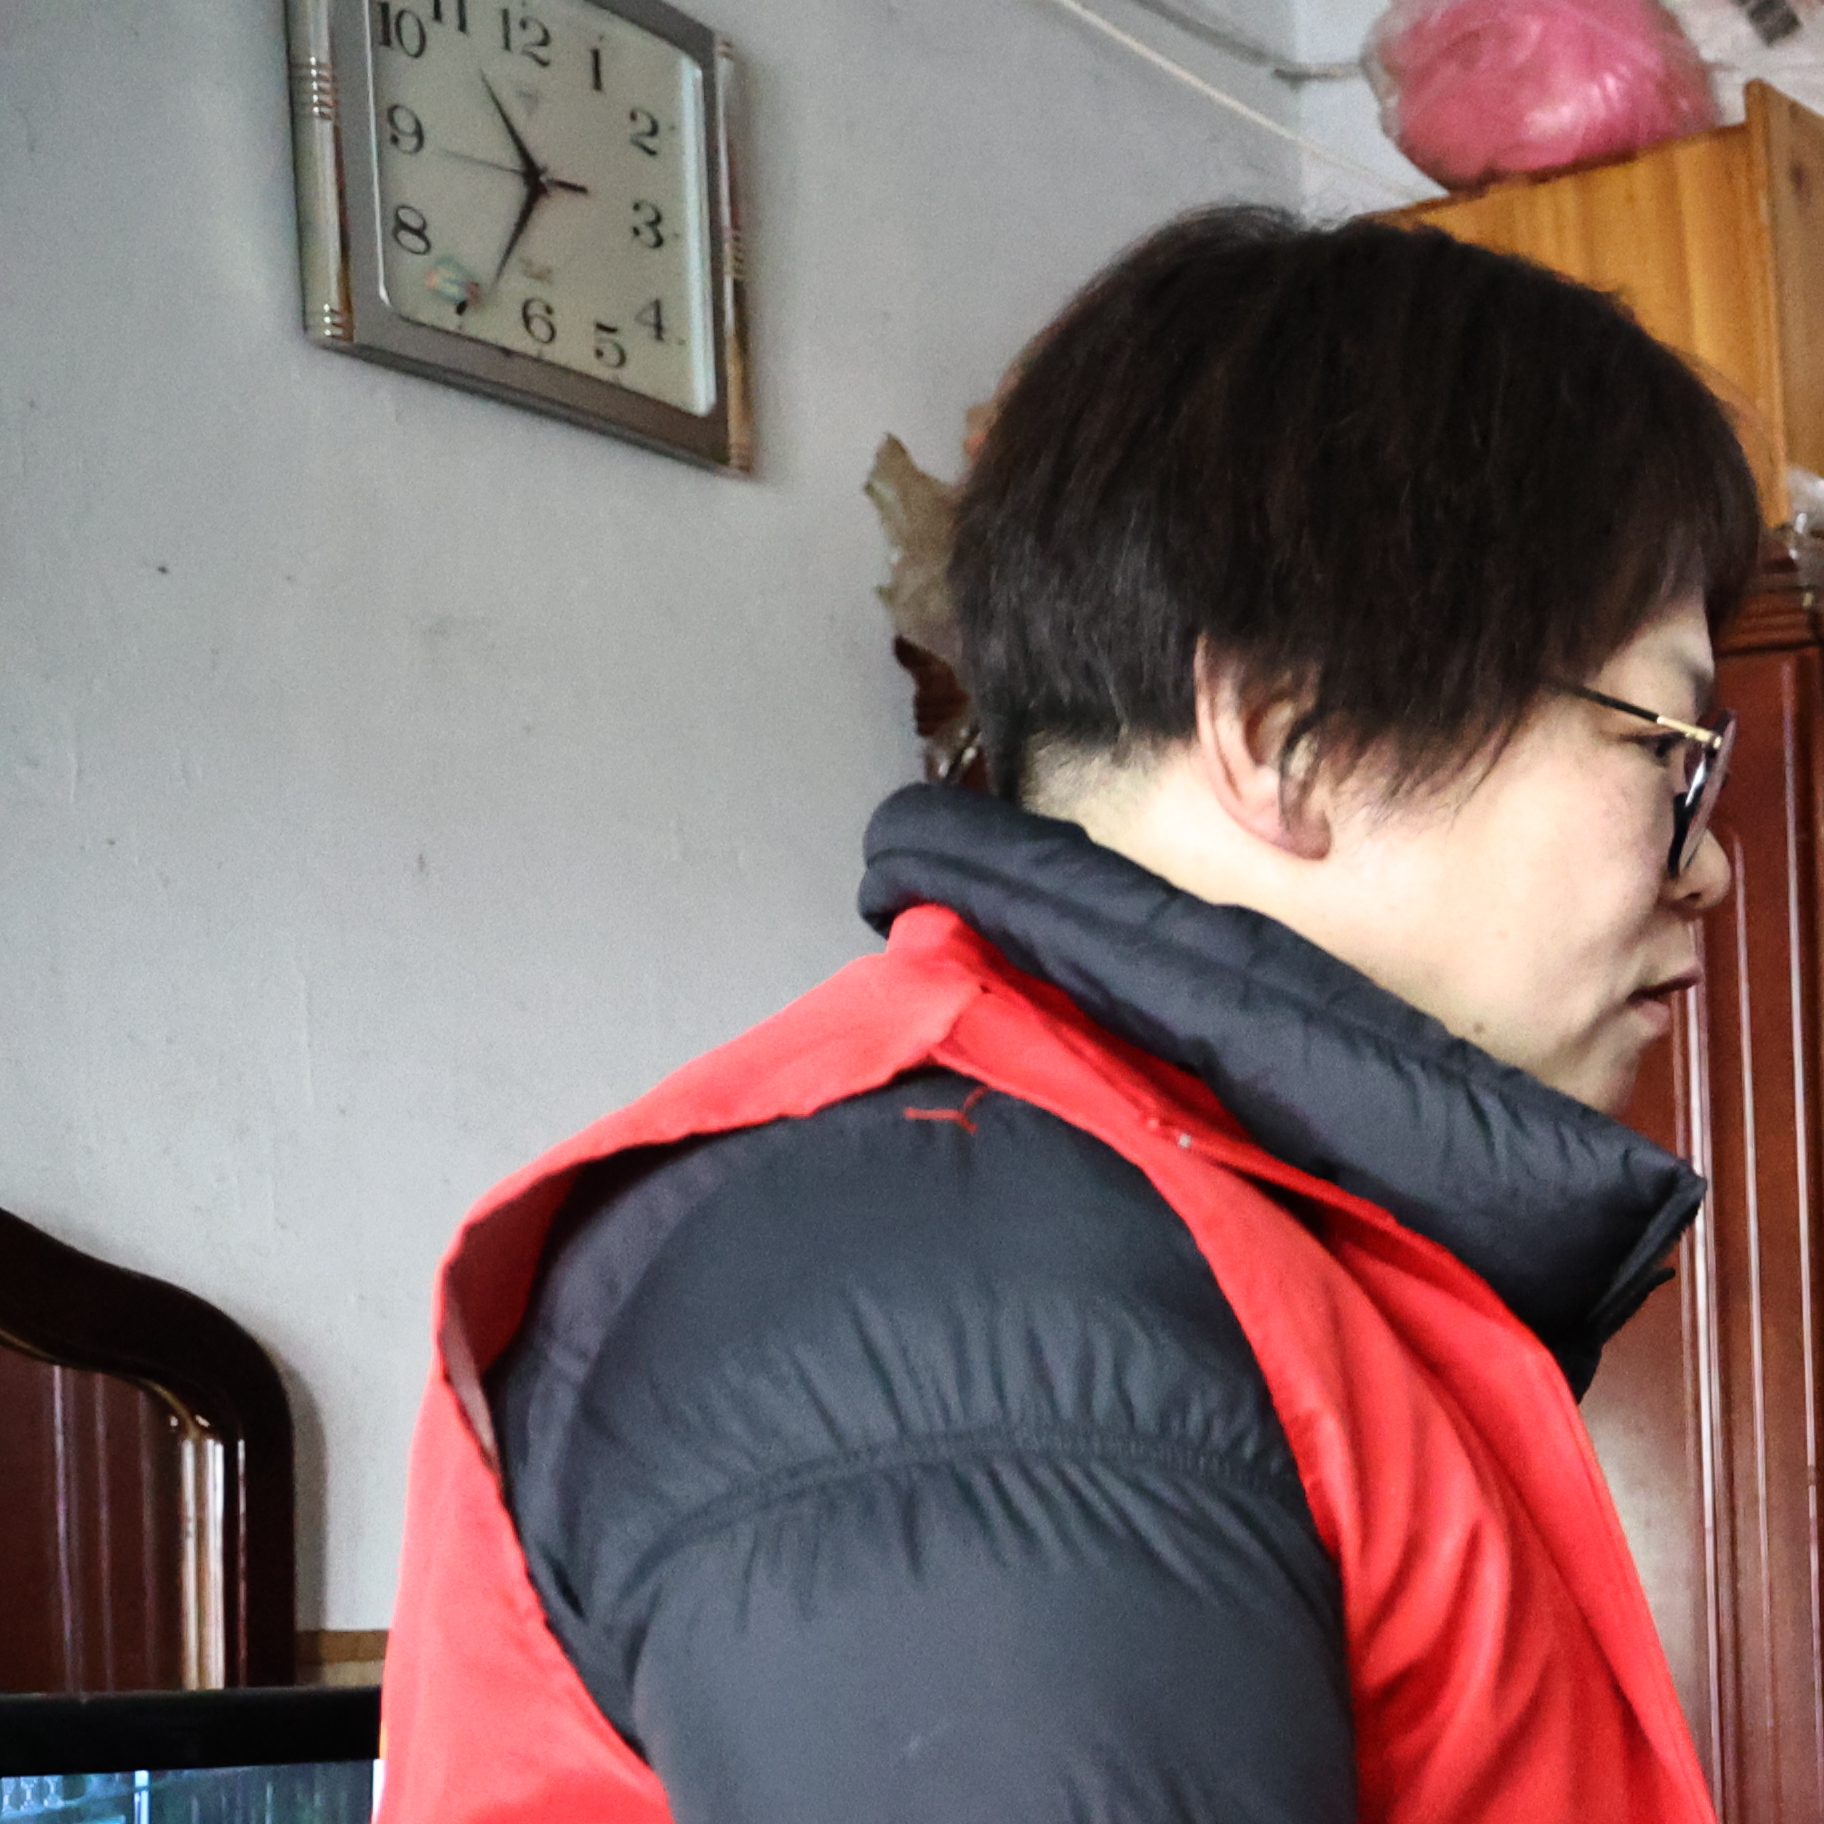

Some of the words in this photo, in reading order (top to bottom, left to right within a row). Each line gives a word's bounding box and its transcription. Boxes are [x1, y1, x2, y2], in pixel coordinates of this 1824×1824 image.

[376, 1, 427, 58] 10
[501, 8, 551, 67] 12
[591, 45, 605, 92] 1
[387, 103, 425, 155] 9
[628, 107, 660, 156] 2
[393, 204, 432, 256] 8
[632, 200, 664, 249] 3
[521, 298, 557, 345] 6
[594, 321, 628, 370] 5
[635, 299, 666, 343] 4
